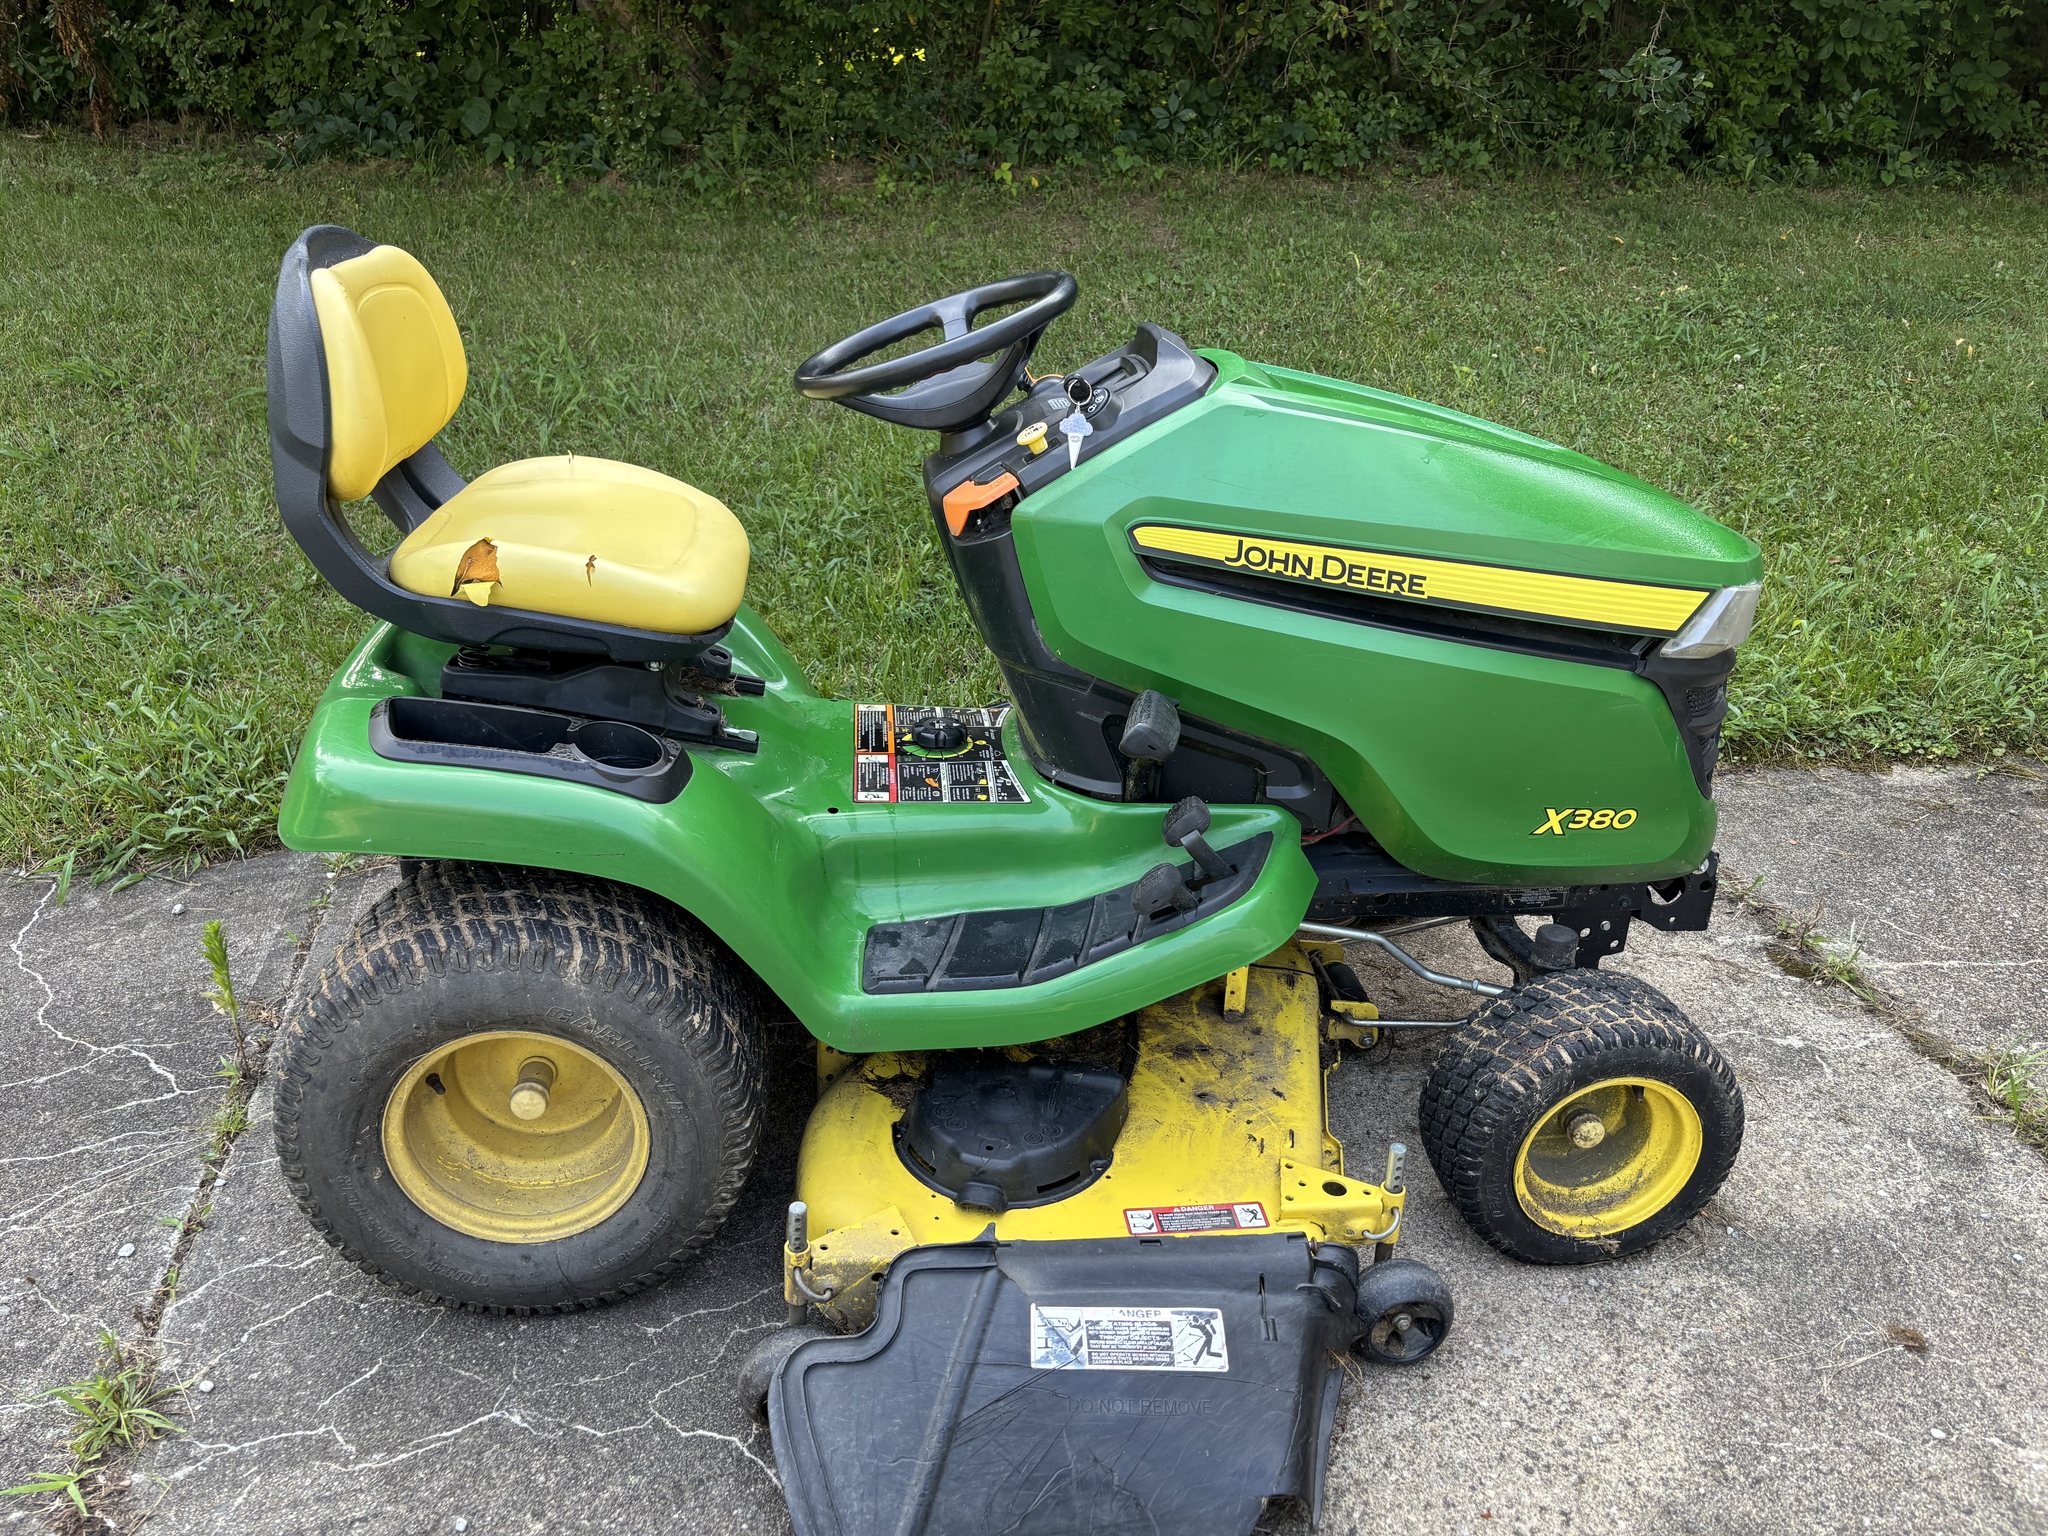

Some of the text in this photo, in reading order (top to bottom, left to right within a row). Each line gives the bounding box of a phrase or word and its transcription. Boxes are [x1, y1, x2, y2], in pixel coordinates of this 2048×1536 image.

[1224, 539, 1428, 596] JOHN DEERE
[1528, 807, 1639, 836] X380
[1113, 1309, 1161, 1318] ANGER
[1068, 1398, 1213, 1415] DO NOT REMOVE
